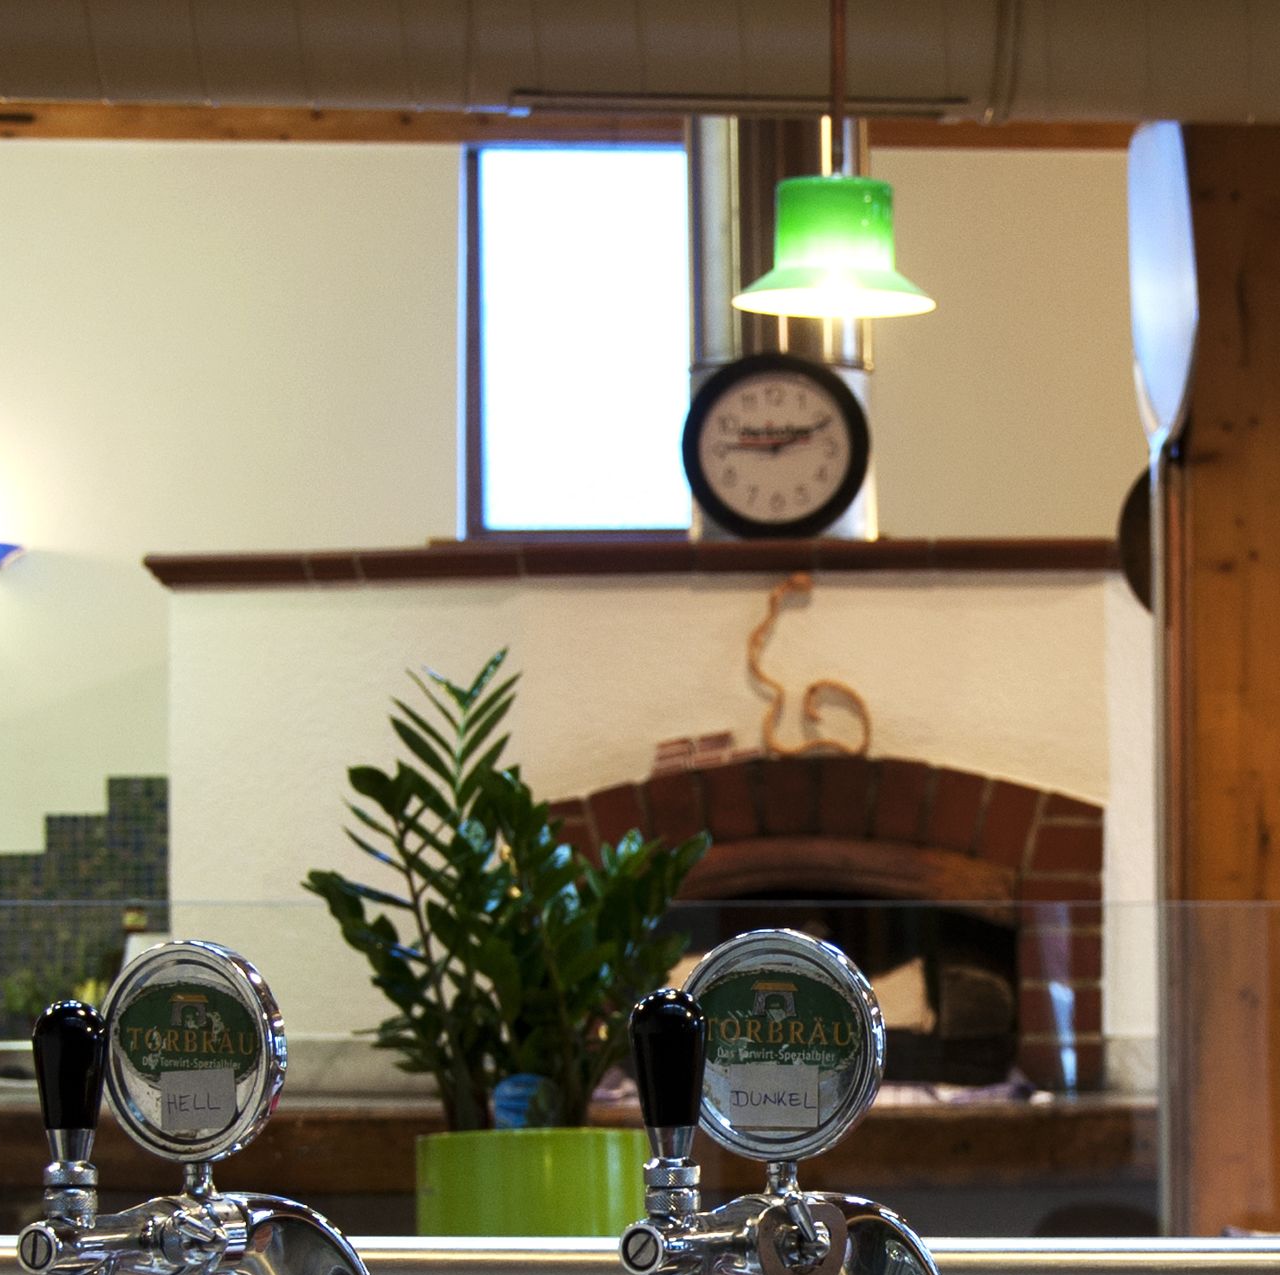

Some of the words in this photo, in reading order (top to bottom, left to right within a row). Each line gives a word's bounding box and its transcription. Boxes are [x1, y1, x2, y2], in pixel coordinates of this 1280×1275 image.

[126, 1026, 257, 1056] TORBRÄU
[706, 1015, 853, 1047] TORBRÄU
[717, 1047, 736, 1059] Das
[166, 1092, 221, 1114] HELL
[732, 1090, 817, 1110] DUNKEL
